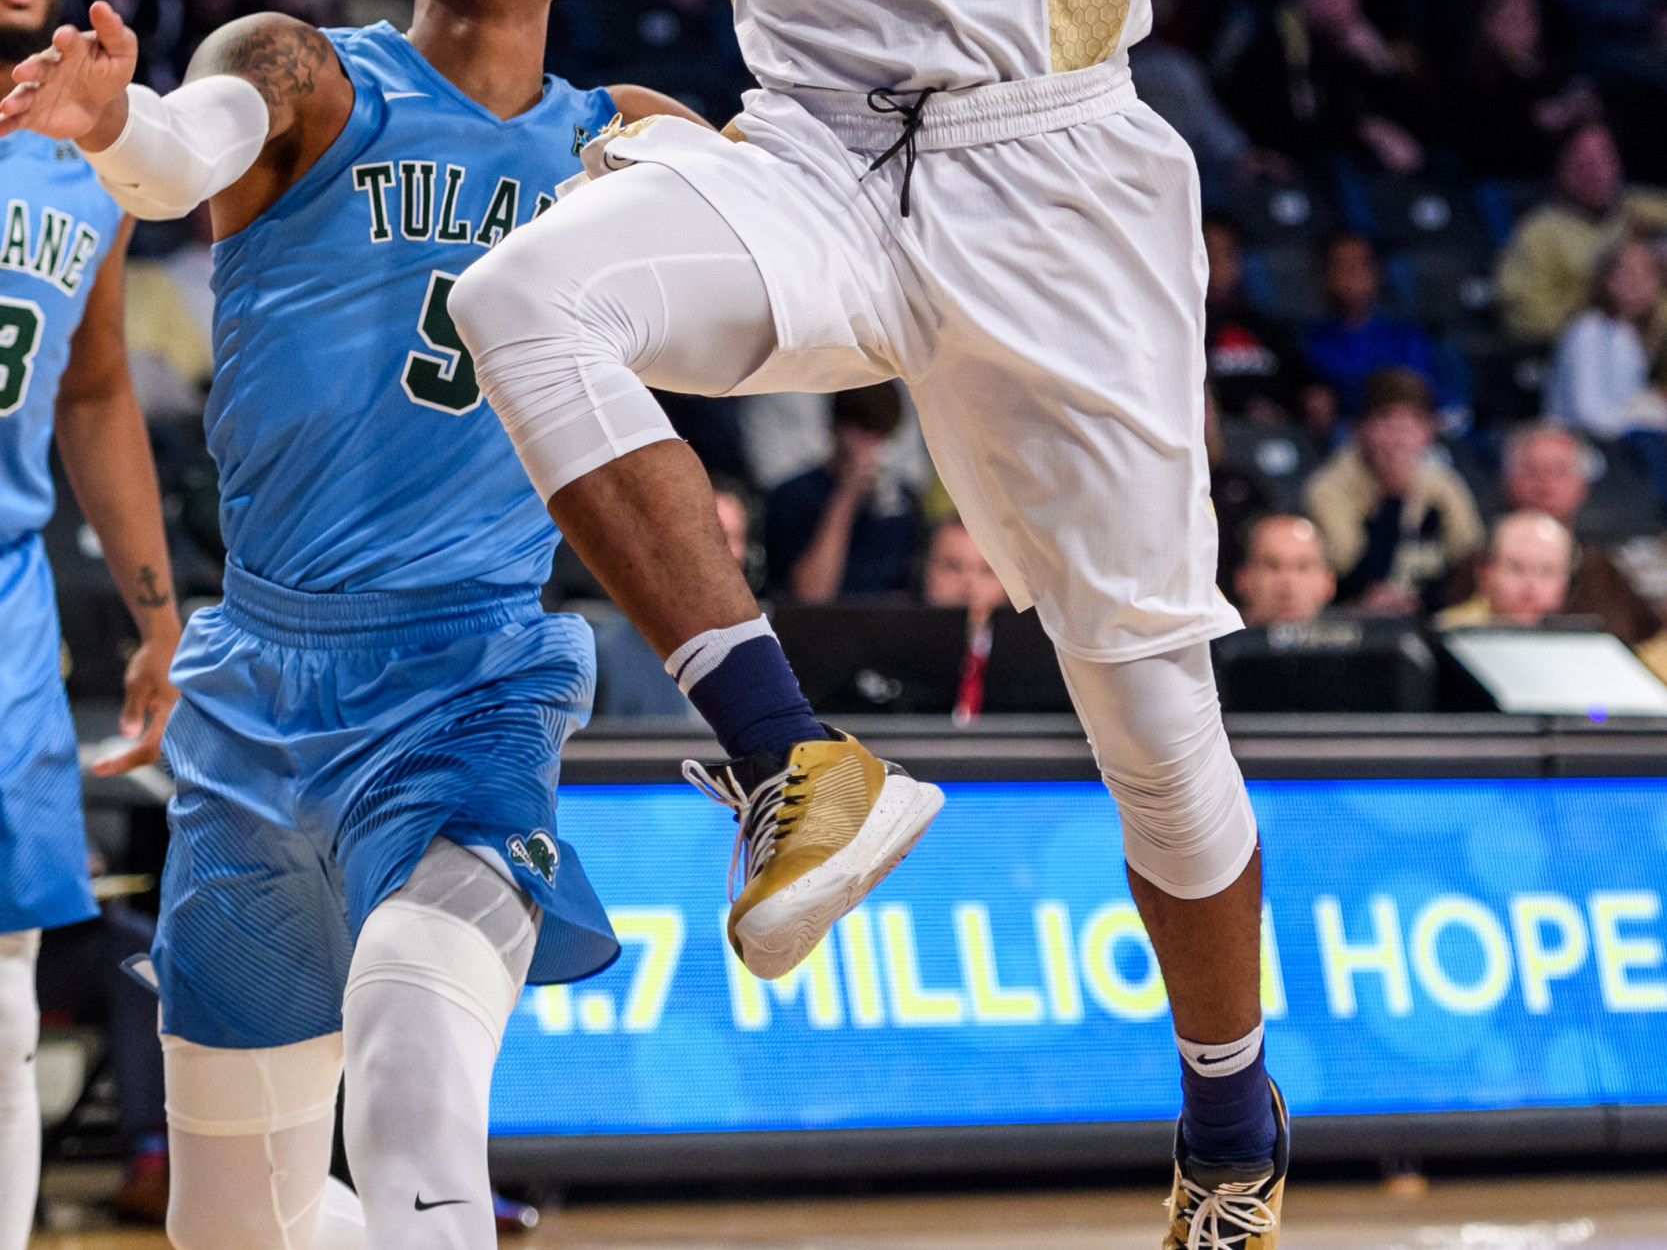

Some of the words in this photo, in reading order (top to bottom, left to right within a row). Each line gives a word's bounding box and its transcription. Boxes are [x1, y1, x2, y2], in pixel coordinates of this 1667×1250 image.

[400, 269, 484, 417] 5
[720, 899, 1286, 1033] MILLIO
[1313, 890, 1667, 1018] HOPE
